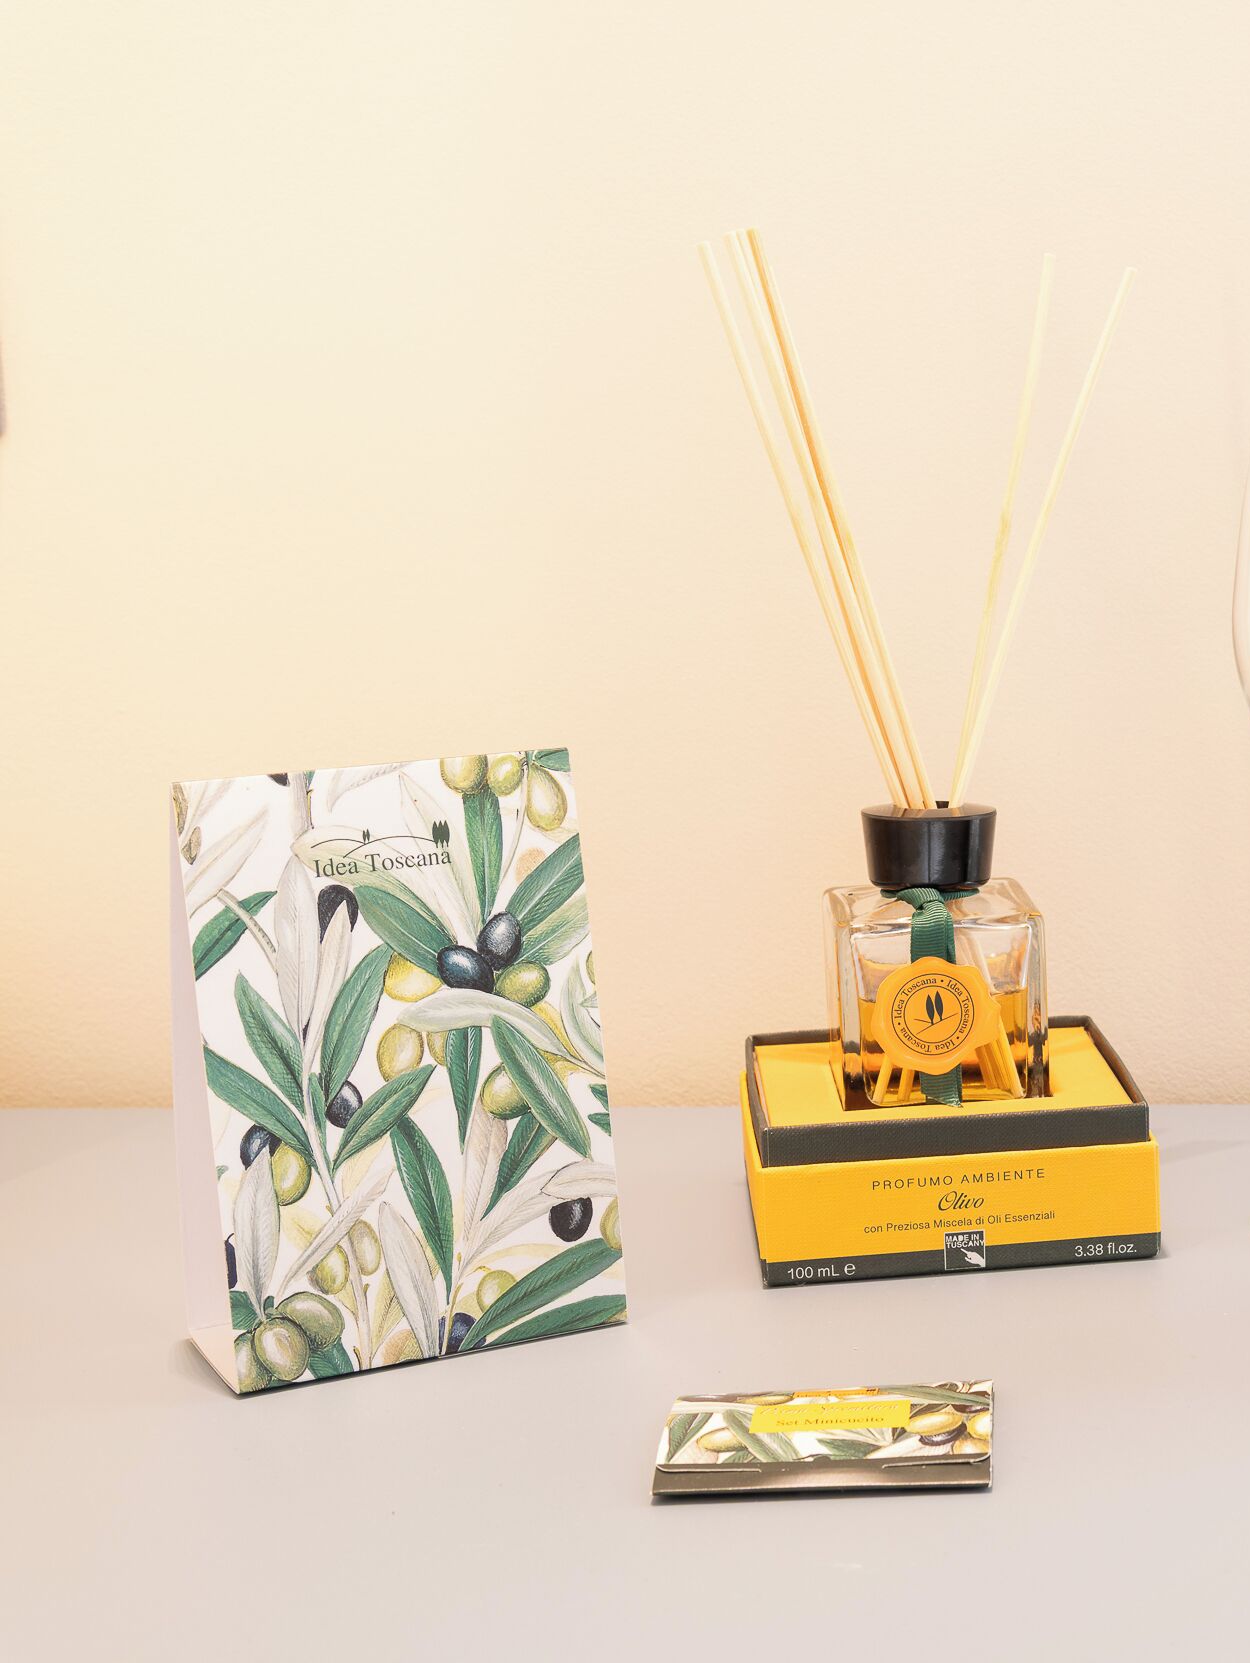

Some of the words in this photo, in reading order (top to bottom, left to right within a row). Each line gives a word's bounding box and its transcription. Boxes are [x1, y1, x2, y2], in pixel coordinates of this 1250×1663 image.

[313, 859, 359, 878] Idea
[365, 851, 452, 873] Toscana
[894, 999, 905, 1019] Idea
[901, 978, 937, 997] Toscana
[946, 980, 963, 997] Idea
[959, 996, 970, 1034] Toscana
[900, 1027, 932, 1053] Toscana
[935, 1039, 955, 1050] Idea
[872, 1175, 953, 1190] PROFUMO
[960, 1168, 1045, 1184] AMBIENTE
[937, 1191, 984, 1211] Olivo
[864, 1224, 883, 1233] con
[886, 1221, 930, 1232] Preziosa
[933, 1217, 972, 1228] Miscela
[976, 1215, 984, 1225] di
[987, 1214, 1001, 1224] Oli
[1004, 1210, 1055, 1222] Essenziali
[945, 1234, 969, 1242] MADE
[971, 1233, 980, 1241] IN
[946, 1240, 985, 1248] TUSCANY
[1074, 1243, 1104, 1257] 3.38
[1107, 1242, 1137, 1255] fl.oz.
[787, 1266, 814, 1280] 100
[817, 1264, 840, 1277] mL
